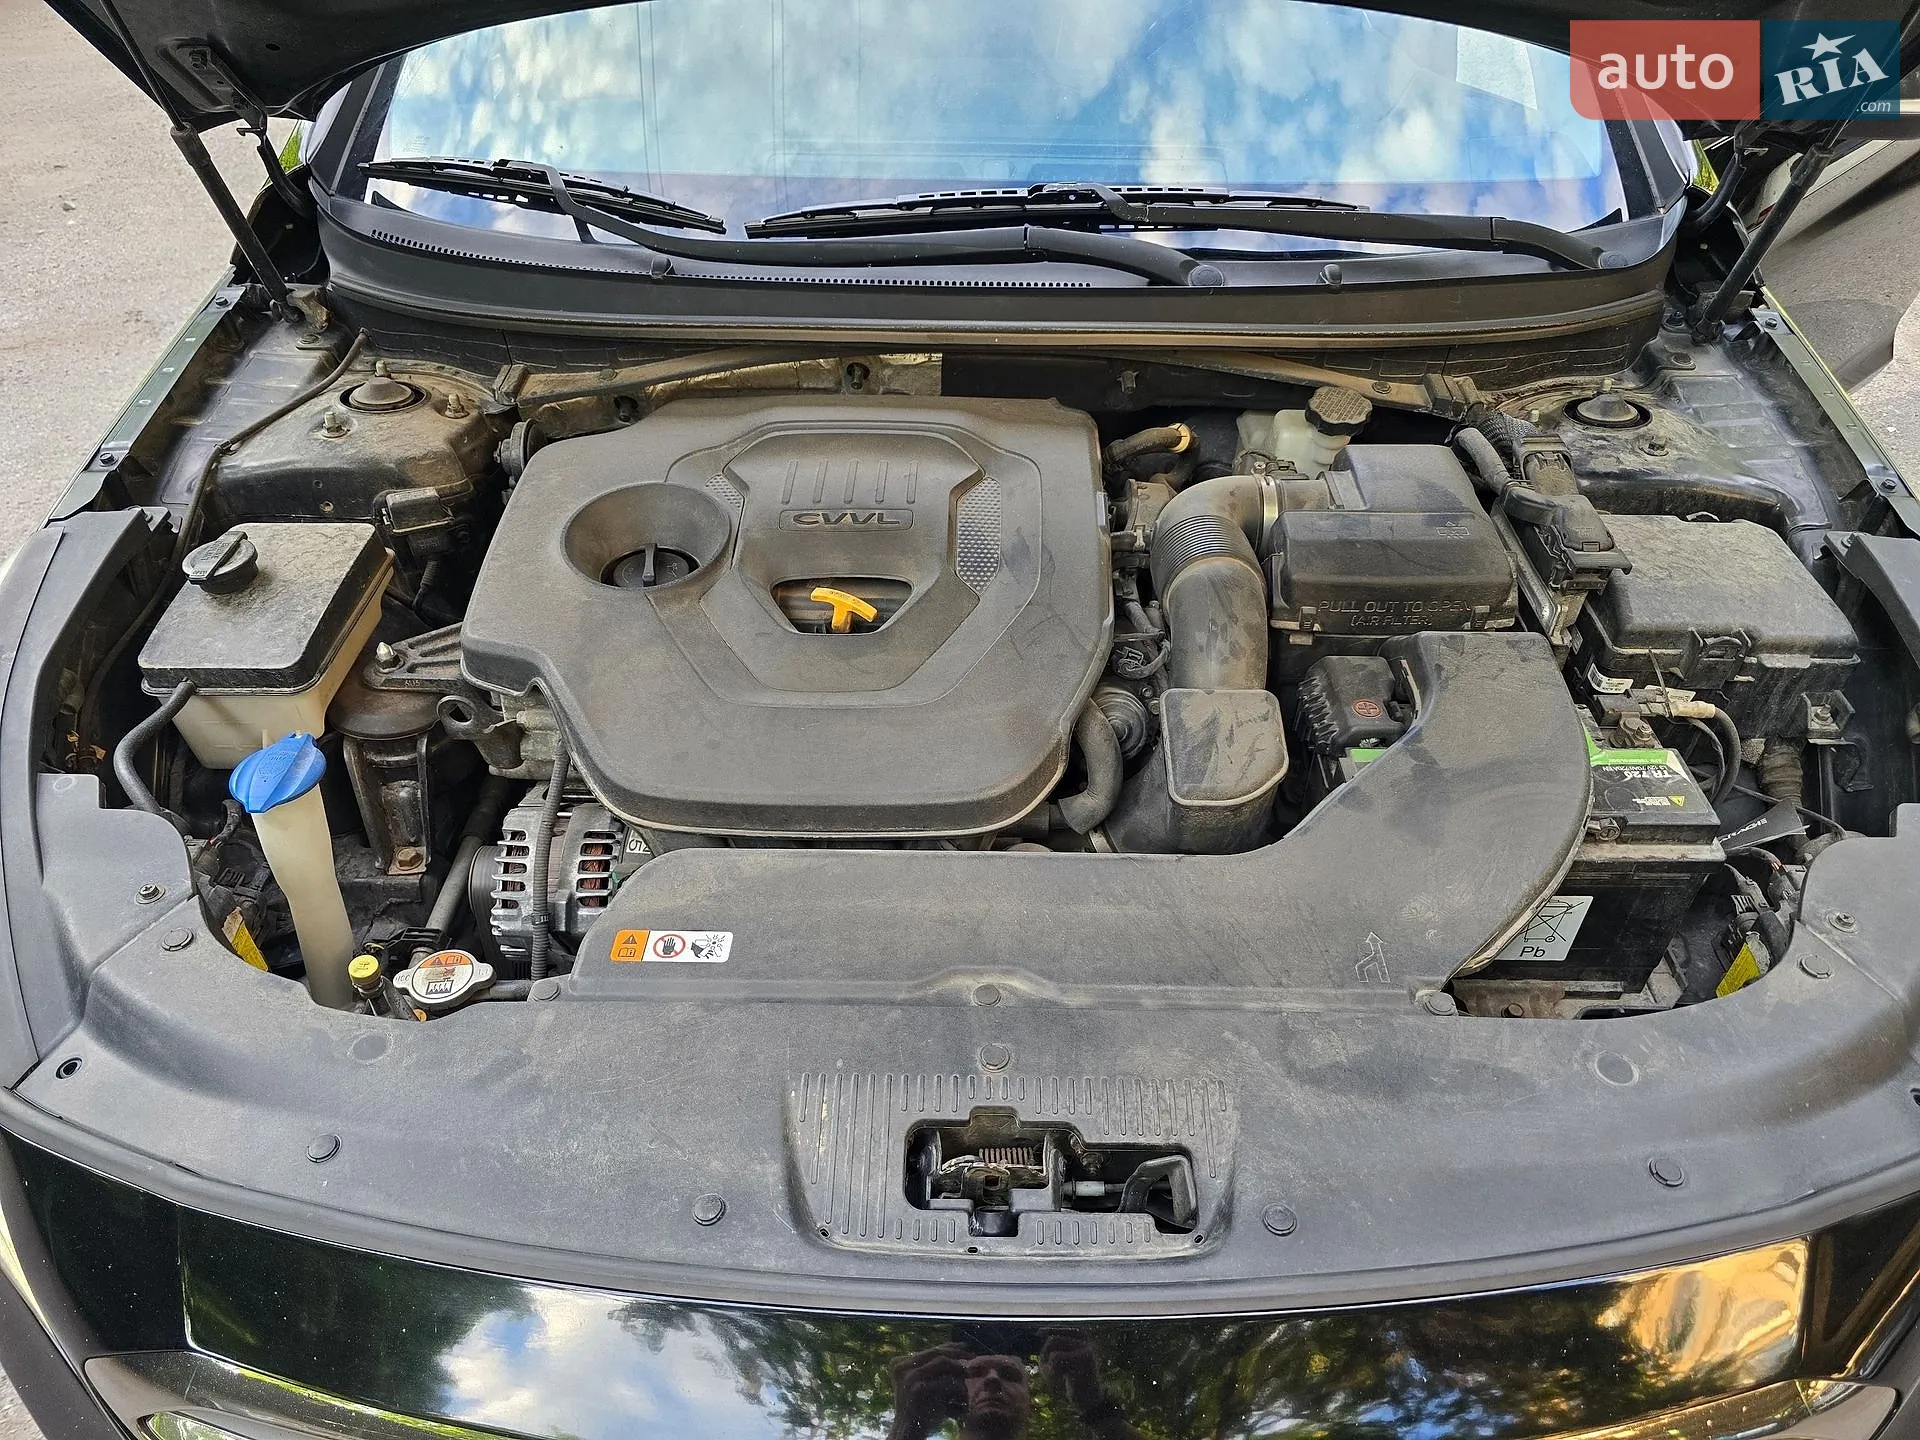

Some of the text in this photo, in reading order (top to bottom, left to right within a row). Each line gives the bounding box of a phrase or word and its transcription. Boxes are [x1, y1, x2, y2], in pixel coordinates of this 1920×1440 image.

[792, 512, 900, 526] CVVL
[1317, 600, 1360, 613] PULL
[1364, 601, 1400, 613] OUT
[1403, 601, 1424, 612] TO
[1519, 946, 1546, 958] Pb
